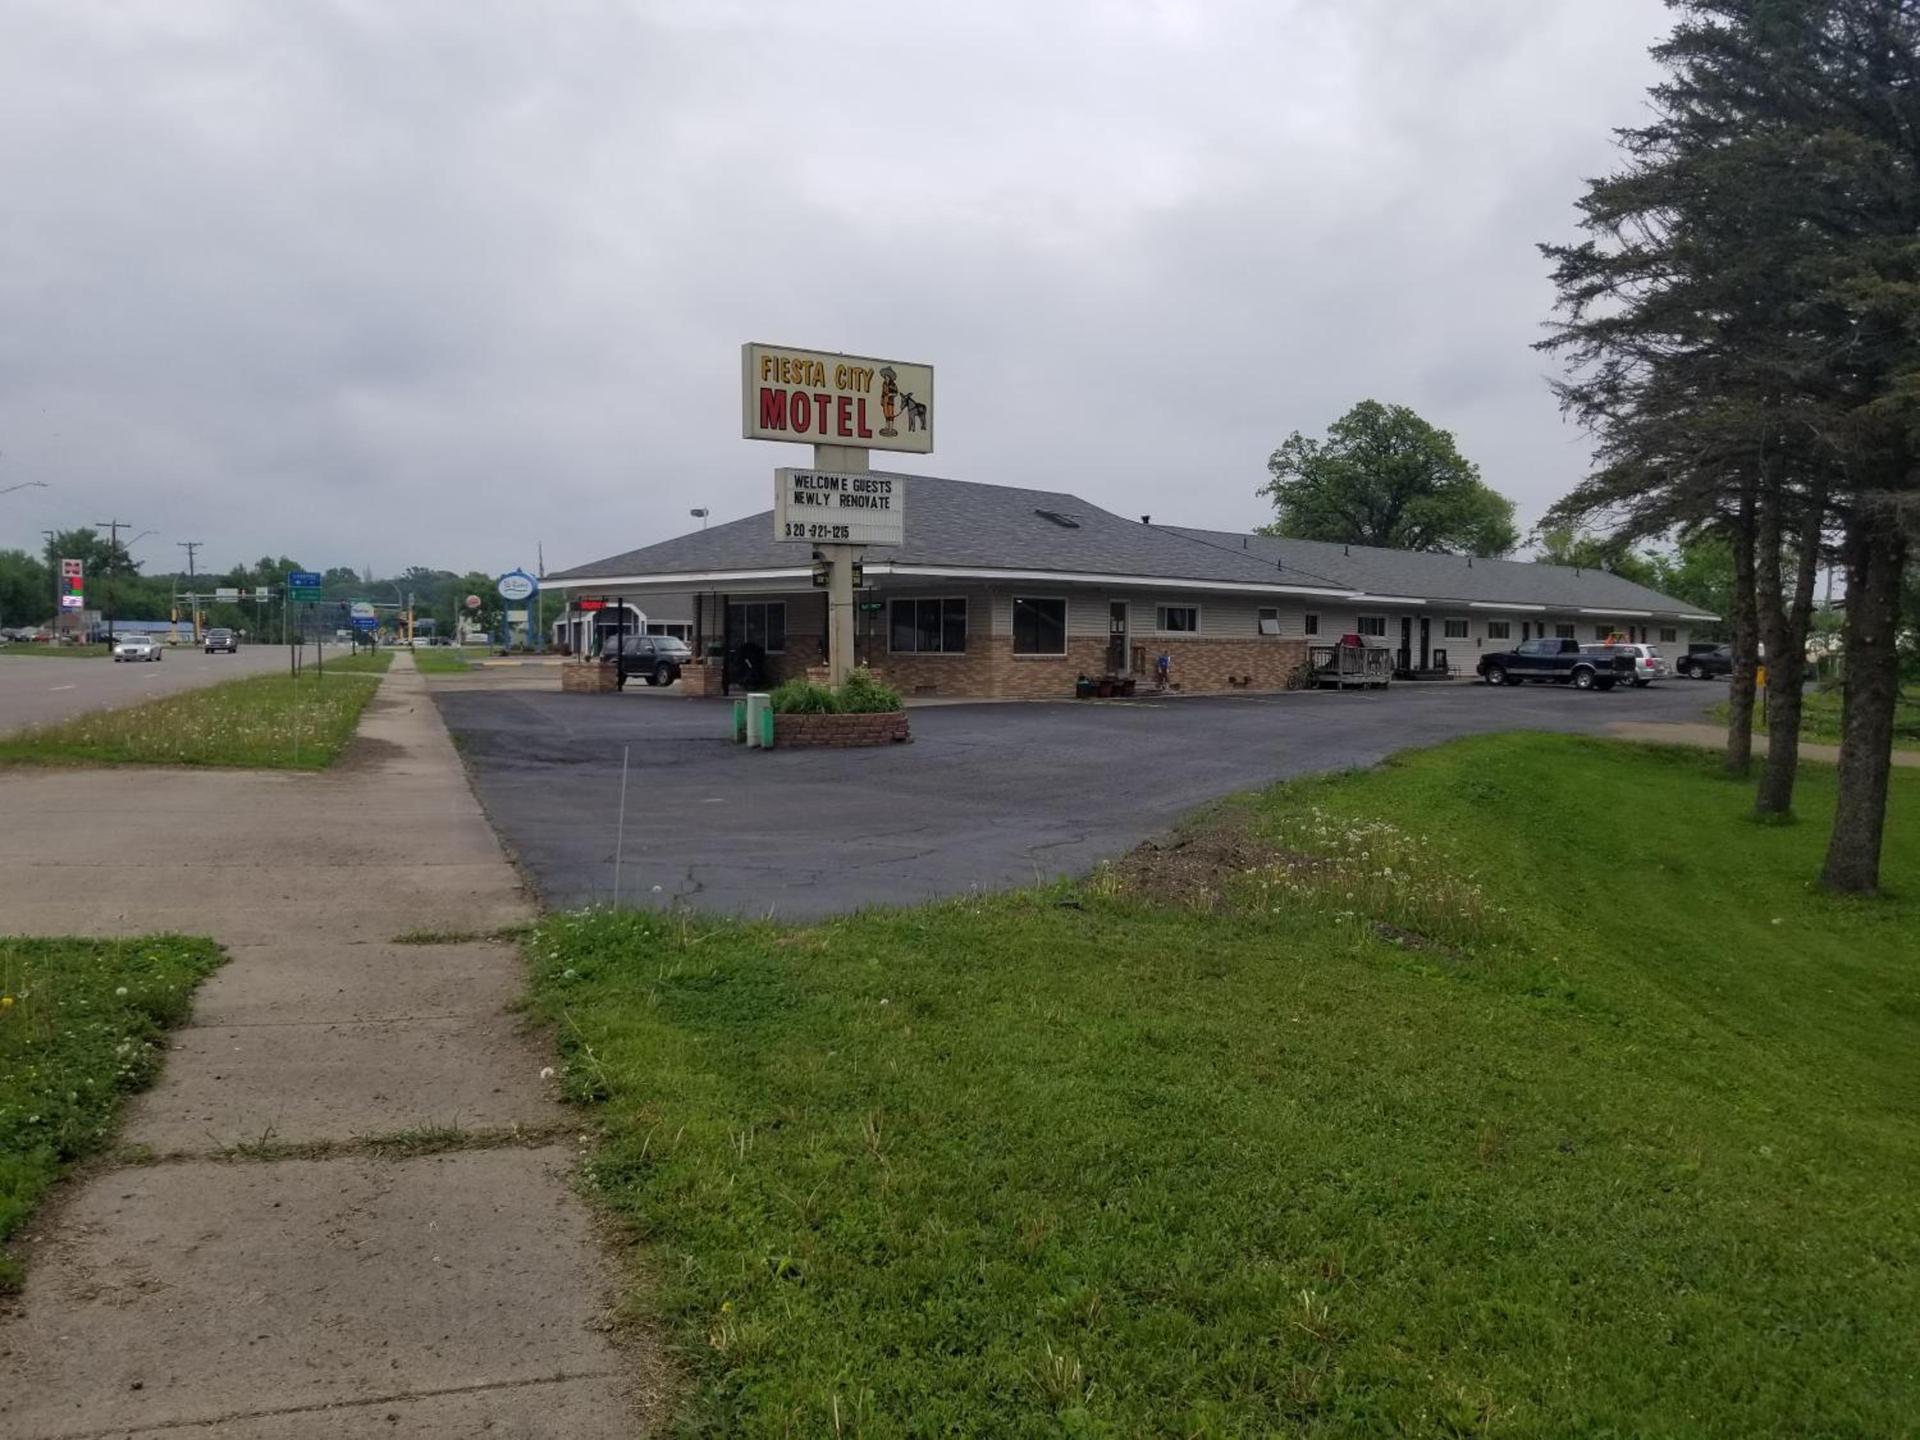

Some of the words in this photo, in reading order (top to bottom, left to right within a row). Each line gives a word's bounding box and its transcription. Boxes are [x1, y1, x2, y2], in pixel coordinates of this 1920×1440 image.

[761, 356, 825, 388] FIESTA
[835, 363, 874, 392] CITY
[760, 388, 873, 438] MOTEL
[794, 474, 848, 491] WELCOME
[853, 479, 892, 494] GUESTS
[794, 491, 830, 506] NEWLY
[839, 494, 890, 509] RENOVATE
